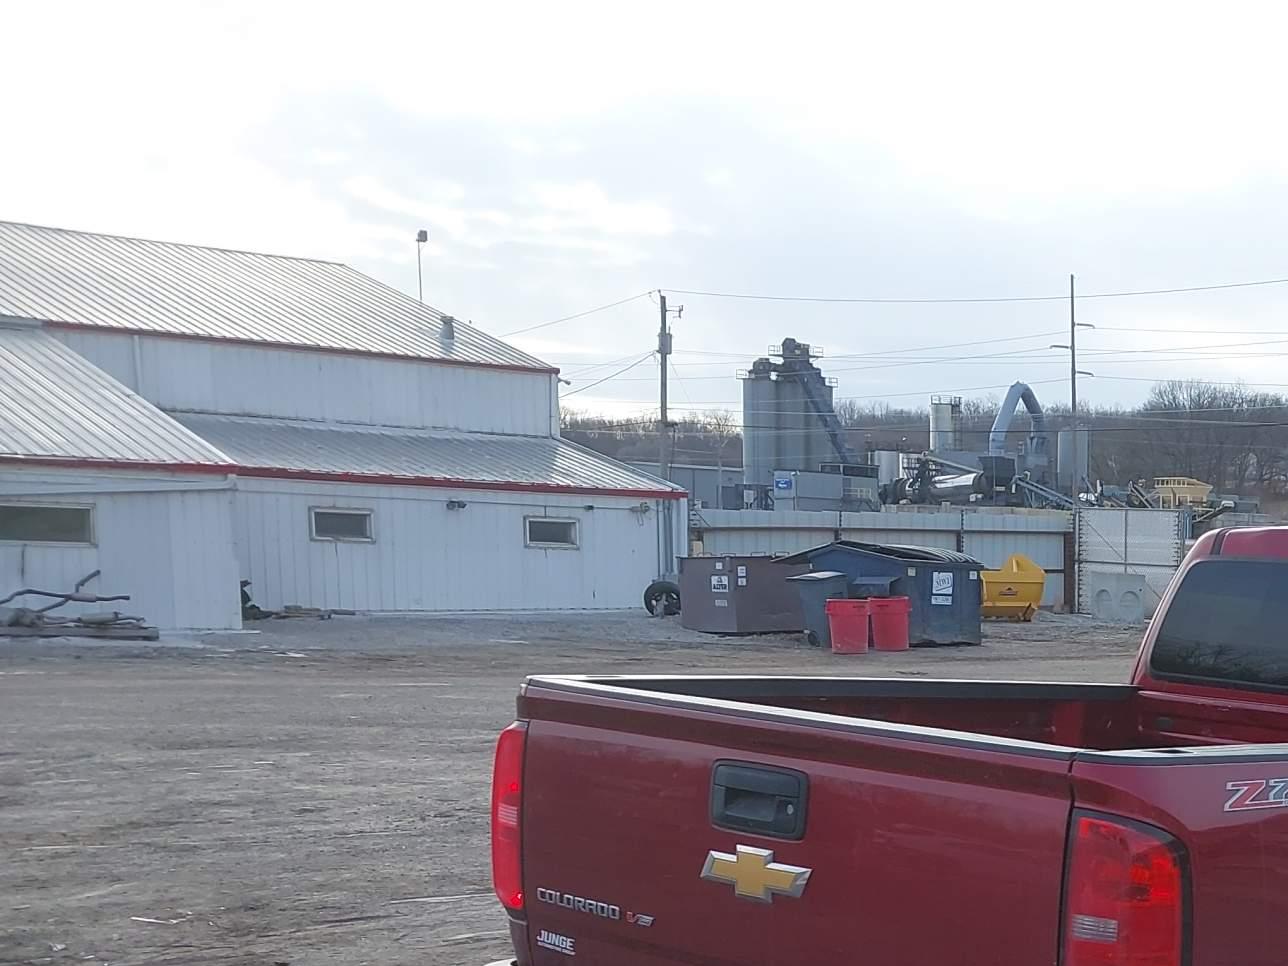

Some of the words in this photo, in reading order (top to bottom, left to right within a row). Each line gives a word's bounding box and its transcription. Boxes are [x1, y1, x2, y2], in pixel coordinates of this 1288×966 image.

[536, 887, 620, 920] COLORADO
[626, 911, 655, 927] V6
[536, 929, 576, 951] JUNGE
